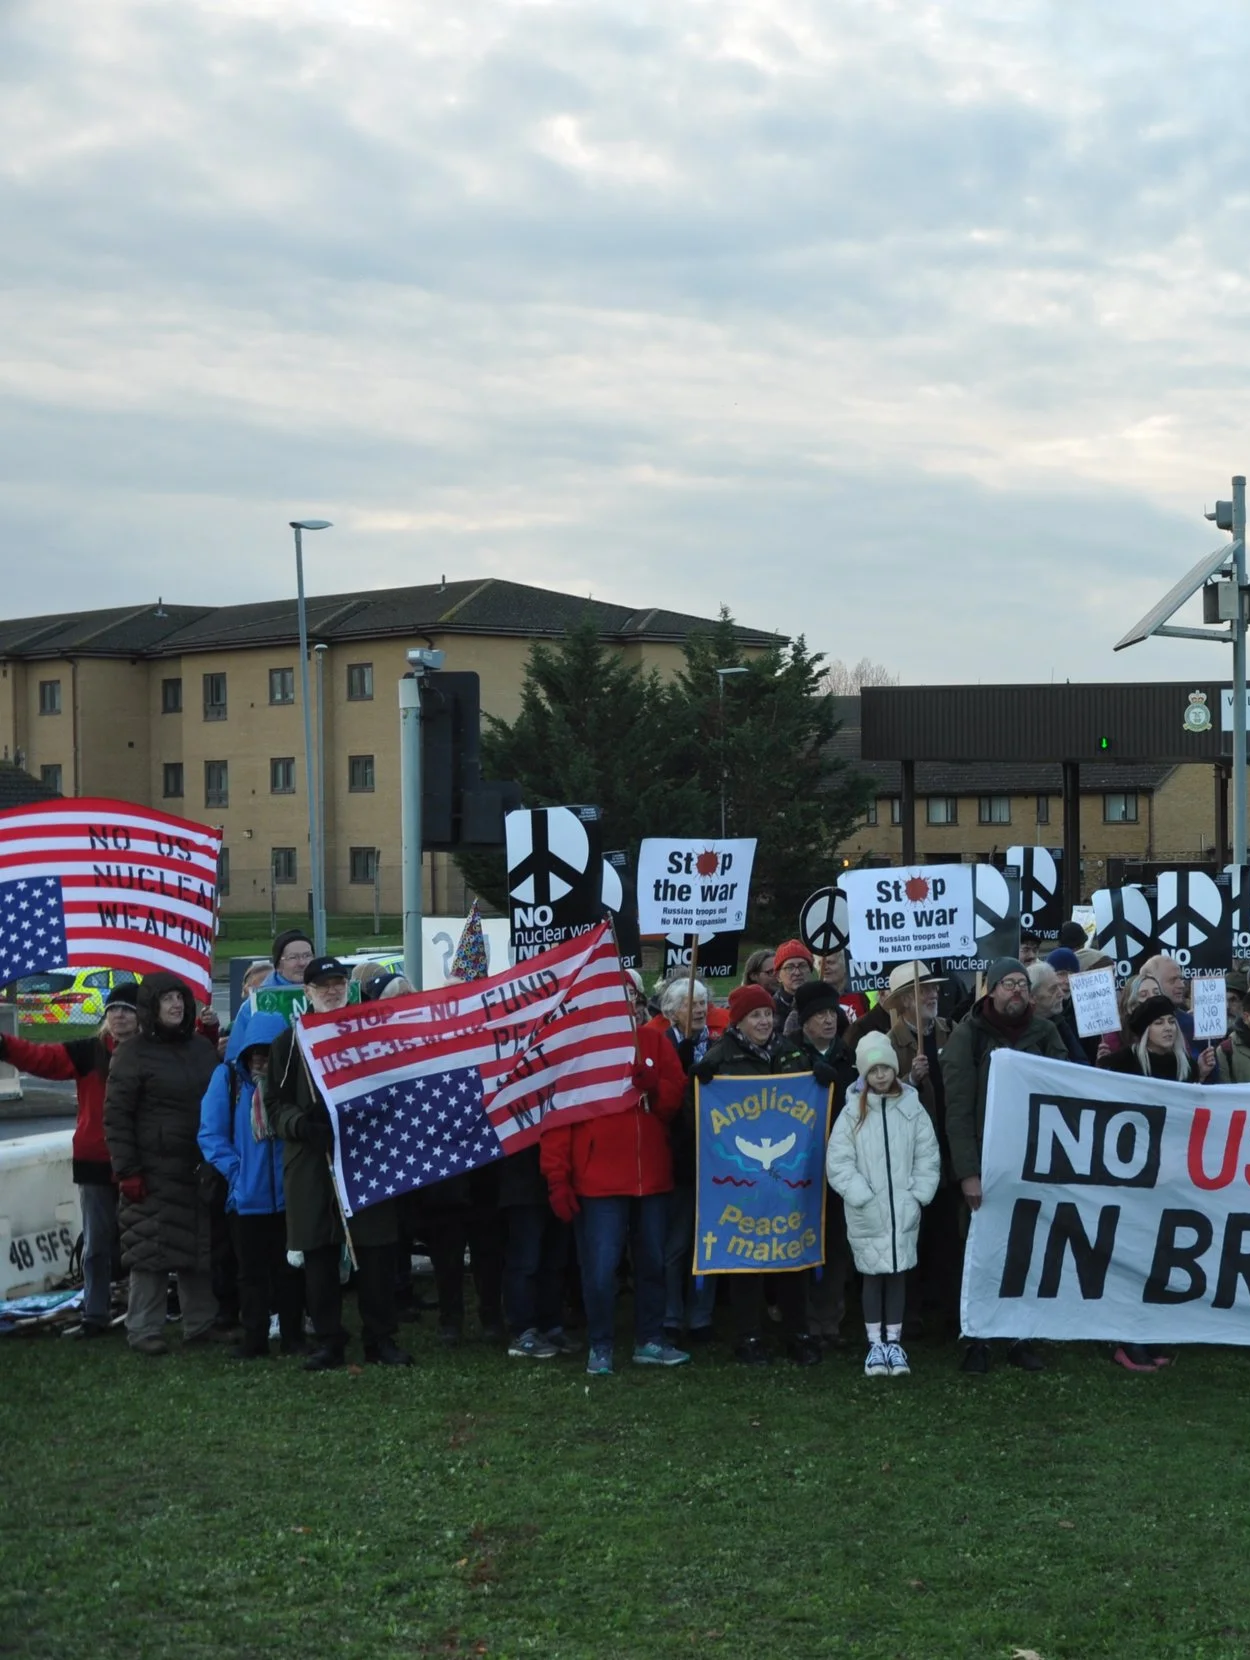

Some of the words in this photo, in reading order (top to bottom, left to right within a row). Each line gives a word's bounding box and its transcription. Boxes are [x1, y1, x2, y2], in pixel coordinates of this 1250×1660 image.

[88, 825, 131, 851] NO
[155, 832, 192, 861] US
[653, 878, 692, 902] the
[700, 882, 738, 902] war
[514, 905, 554, 928] NO
[660, 917, 671, 926] No
[672, 917, 694, 926] NATO
[695, 917, 728, 928] expansion
[662, 907, 693, 916] Russian
[695, 908, 717, 917] troops
[718, 906, 728, 914] out
[865, 908, 905, 931] the
[913, 907, 958, 928] war
[97, 902, 212, 955] WEAPON
[514, 926, 568, 945] nuclear
[569, 922, 597, 938] war
[879, 935, 910, 944] Russian
[912, 932, 936, 943] troops
[937, 931, 950, 939] out
[1043, 929, 1061, 940] war
[878, 945, 889, 954] No
[891, 944, 912, 953] NATO
[913, 941, 951, 952] expansion
[709, 964, 733, 977] war
[849, 959, 884, 978] NO
[945, 957, 989, 972] nuclear
[1207, 967, 1229, 979] war
[850, 976, 891, 992] nuclea
[481, 969, 560, 1023] FUND
[335, 1005, 396, 1035] STOP
[492, 999, 580, 1061] PEE
[1198, 1017, 1222, 1033] WAR
[710, 1085, 818, 1136] Anglican
[1034, 1101, 1154, 1180] NO
[717, 1203, 802, 1237] Peace
[9, 1239, 35, 1272] 48
[1000, 1198, 1121, 1300] IN
